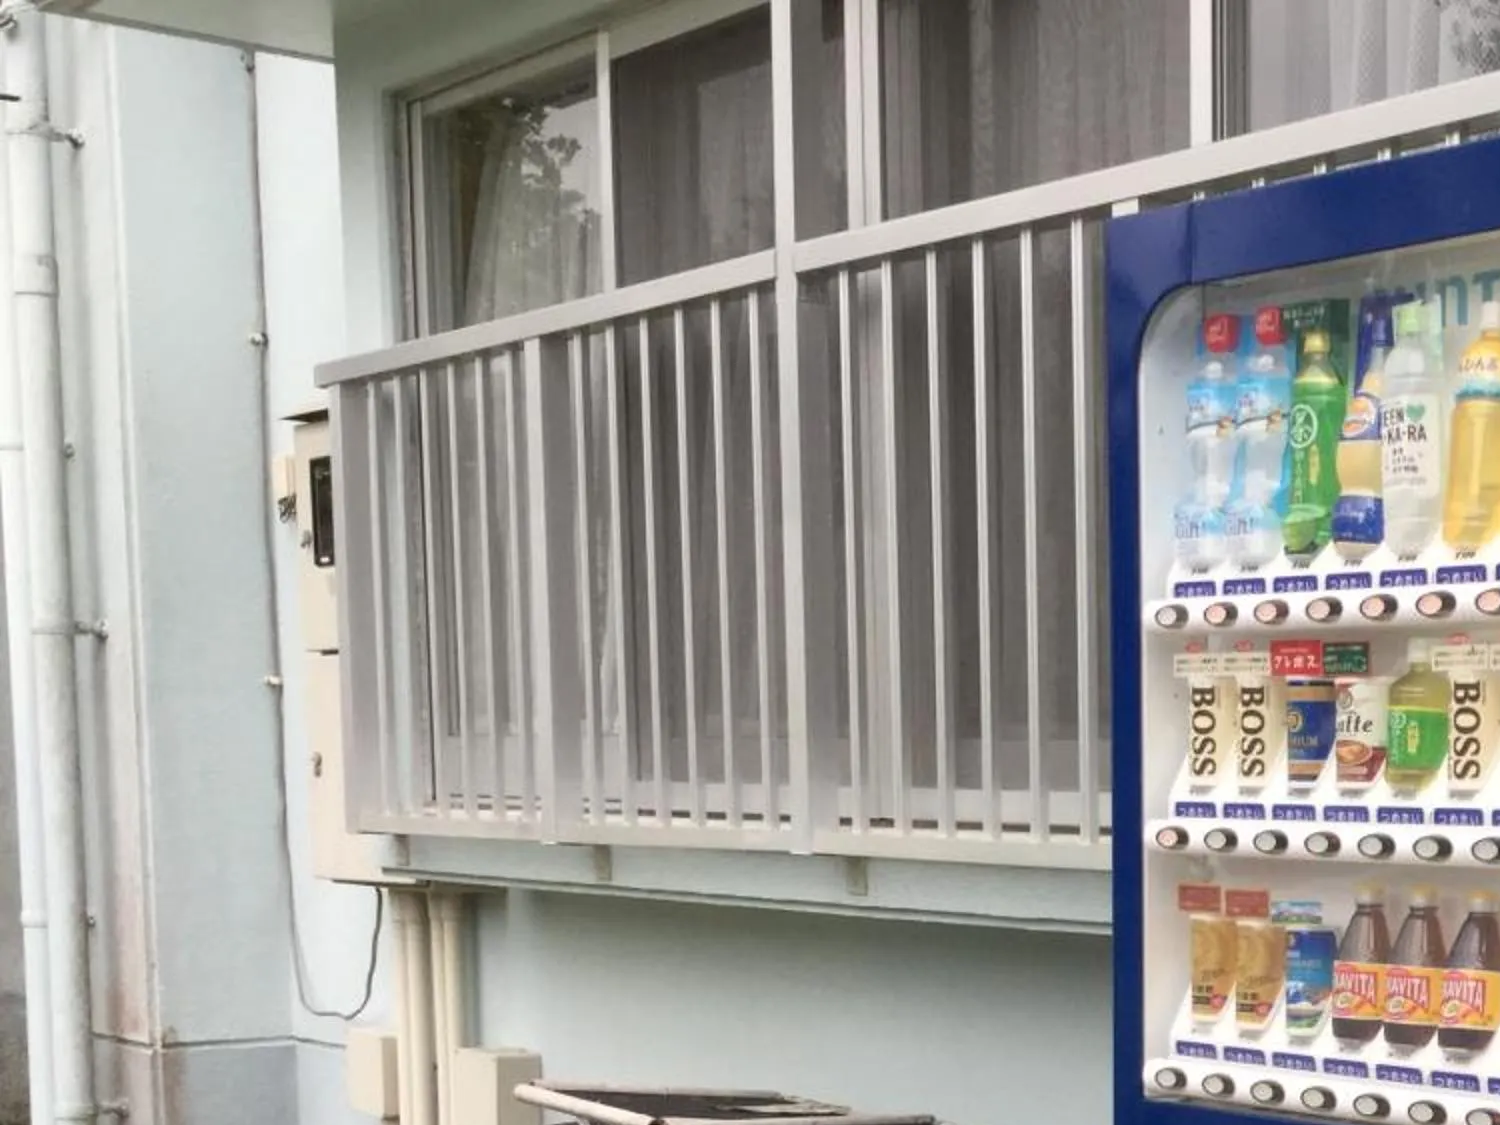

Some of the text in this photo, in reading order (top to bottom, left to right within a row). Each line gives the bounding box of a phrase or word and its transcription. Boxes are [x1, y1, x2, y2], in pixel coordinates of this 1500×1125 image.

[1191, 685, 1217, 777] BOSS
[1240, 685, 1266, 778] BOSS
[1336, 715, 1373, 733] atte
[1453, 680, 1482, 781] BOSS
